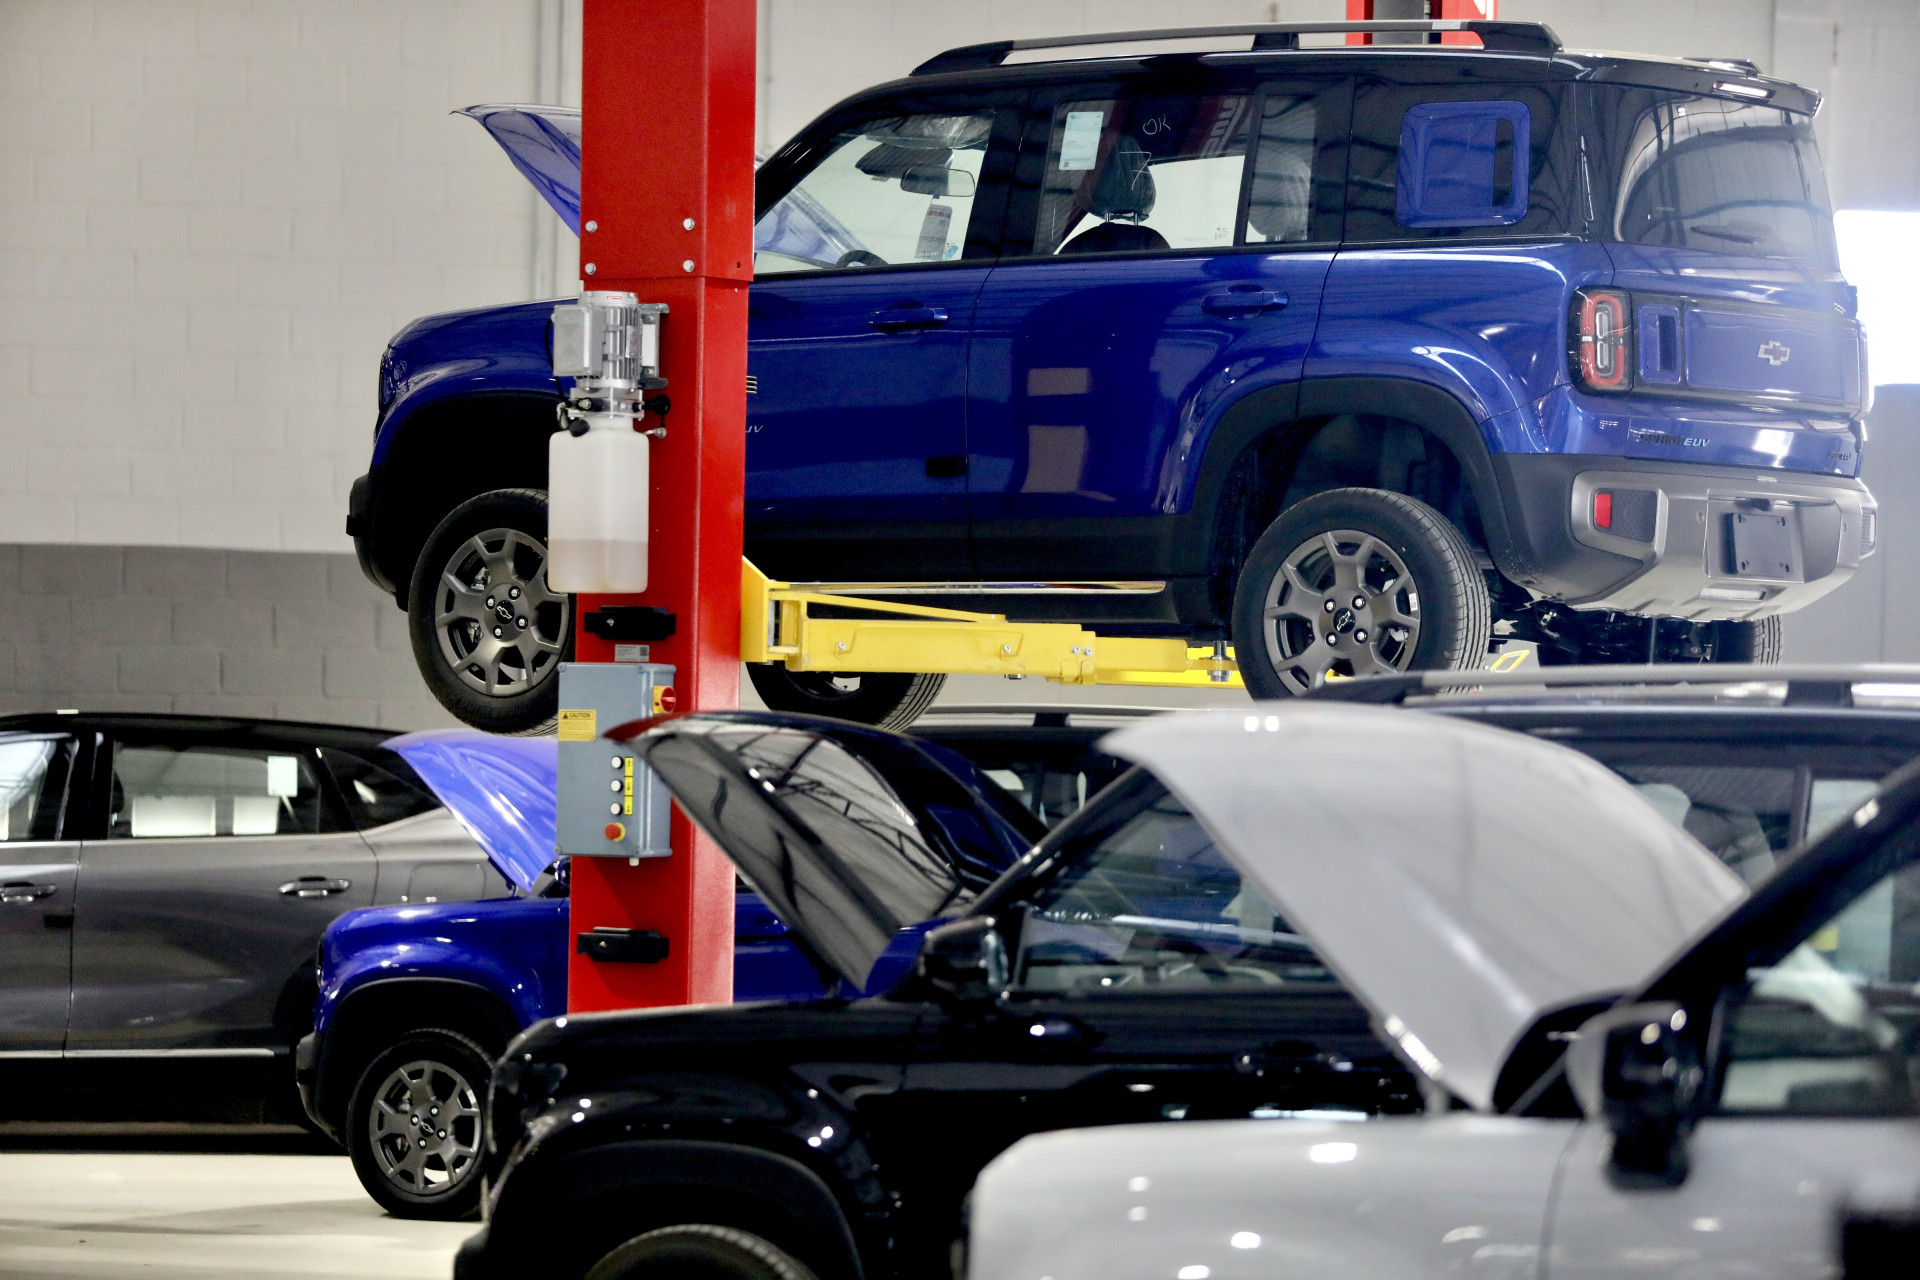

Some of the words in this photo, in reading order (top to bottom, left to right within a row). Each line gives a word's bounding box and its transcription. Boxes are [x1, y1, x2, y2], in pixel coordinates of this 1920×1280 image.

[1142, 113, 1171, 135] OK
[1119, 151, 1152, 192] 7
[1684, 437, 1710, 447] EUV
